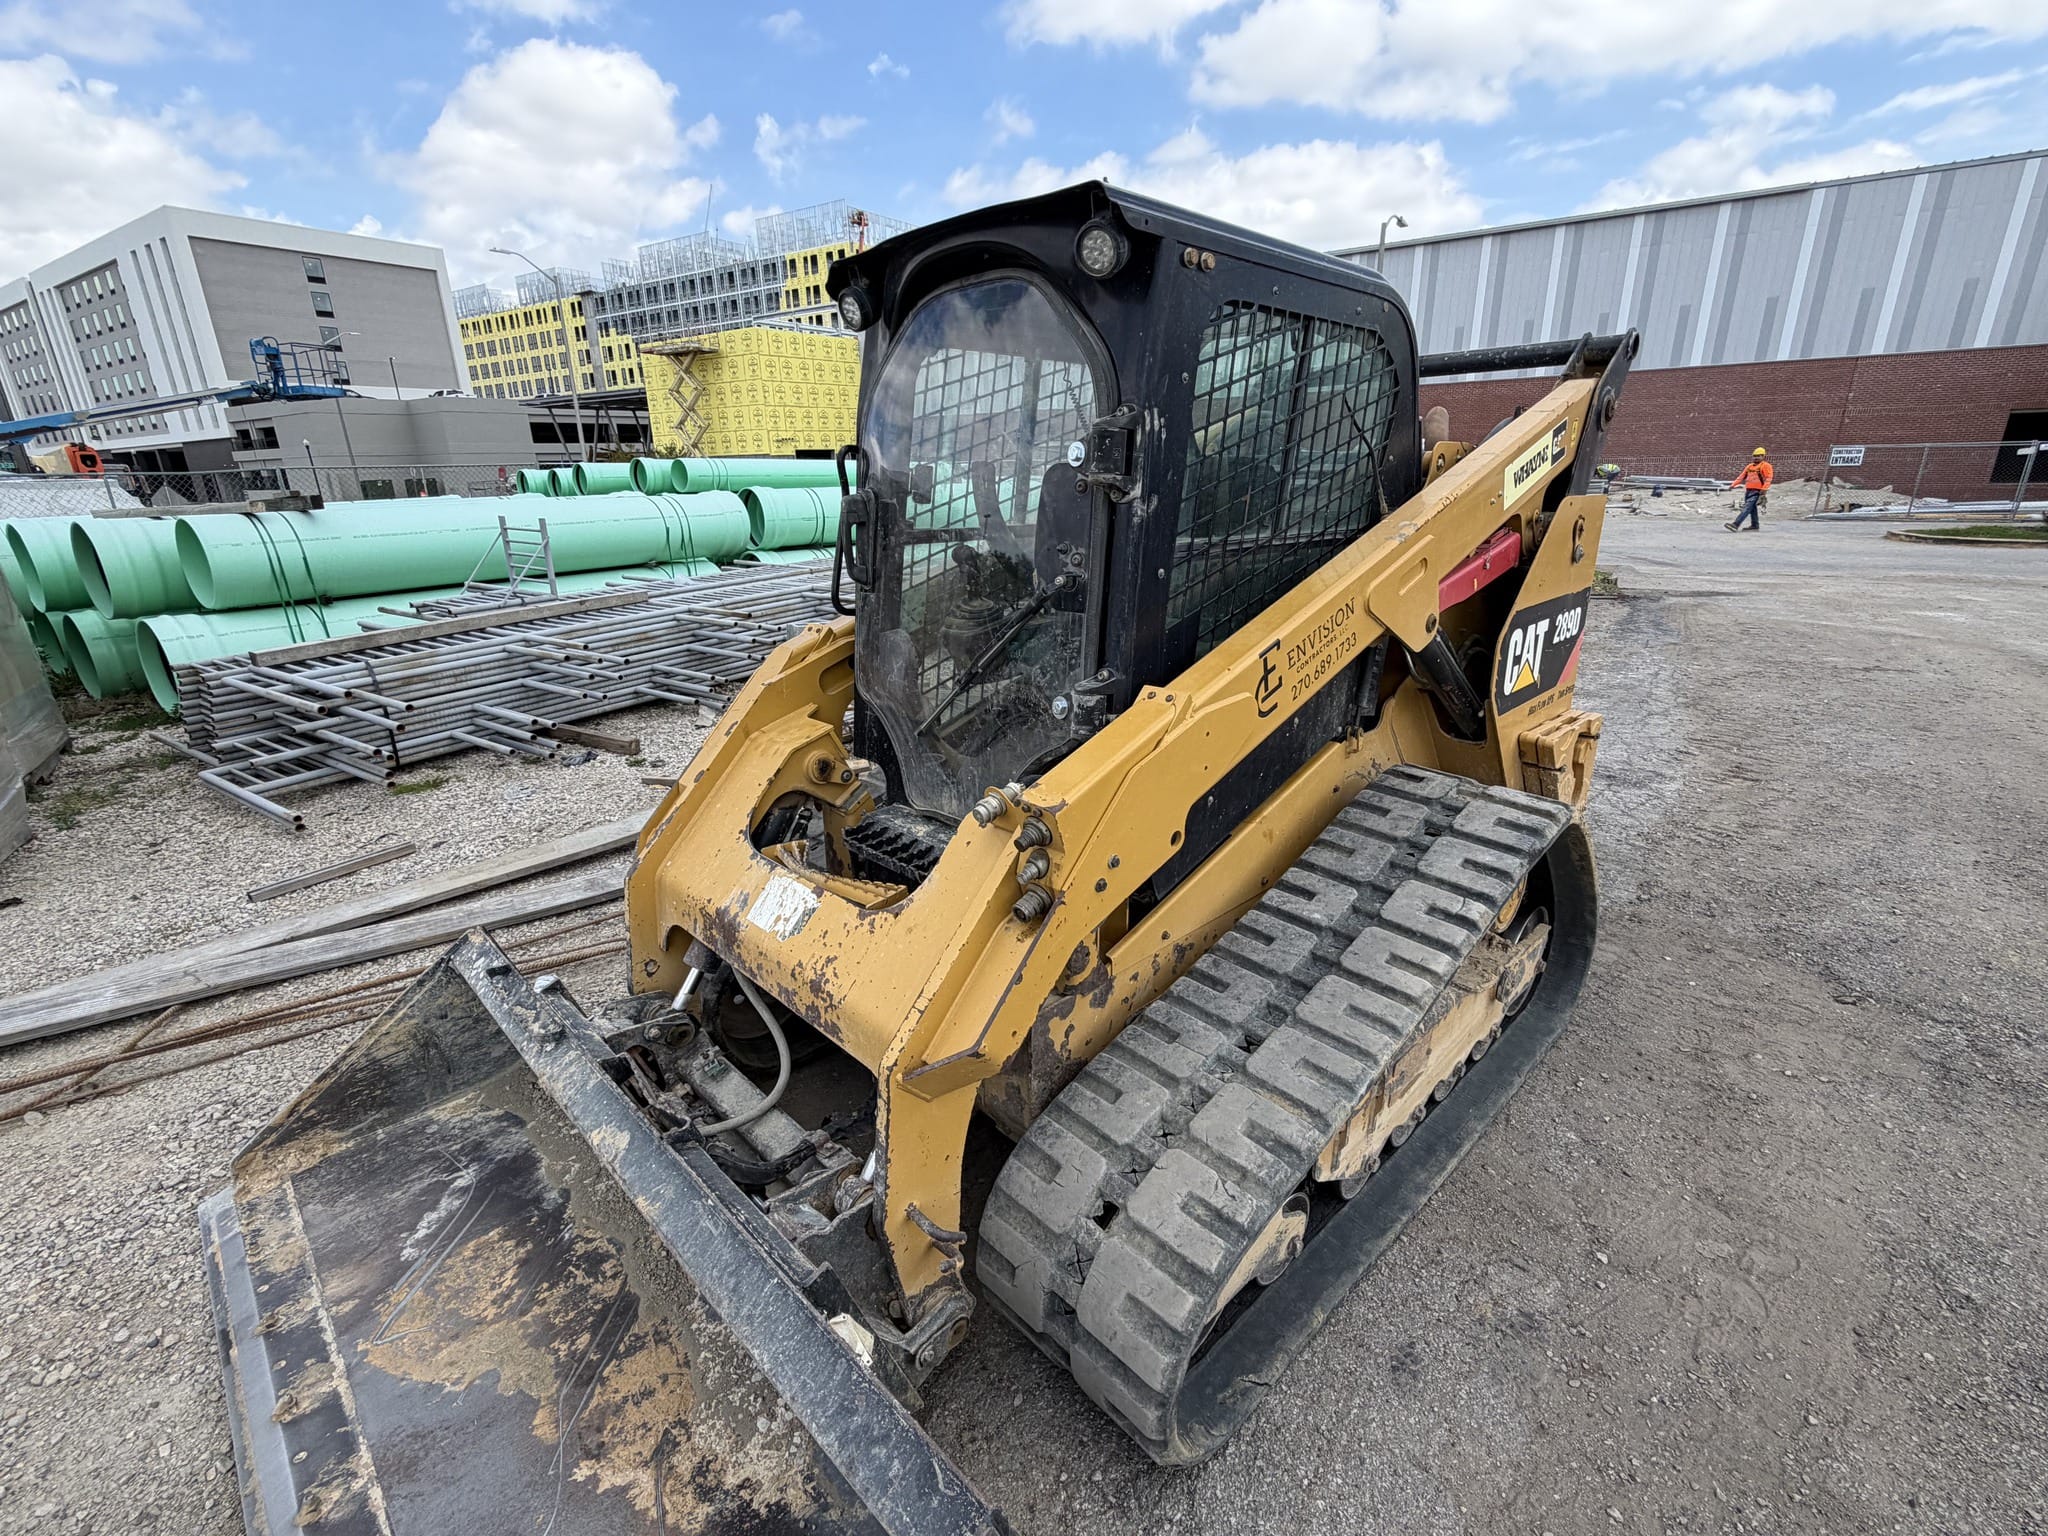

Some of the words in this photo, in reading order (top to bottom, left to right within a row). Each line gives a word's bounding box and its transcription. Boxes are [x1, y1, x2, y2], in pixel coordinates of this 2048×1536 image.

[1831, 456, 1861, 464] ENTRANCE
[1286, 597, 1355, 670] ENVISION
[1552, 607, 1582, 644] 289D
[1290, 632, 1357, 701] 270.689.1733
[1296, 633, 1337, 674] CONTRACTORS
[1503, 618, 1550, 696] CAT
